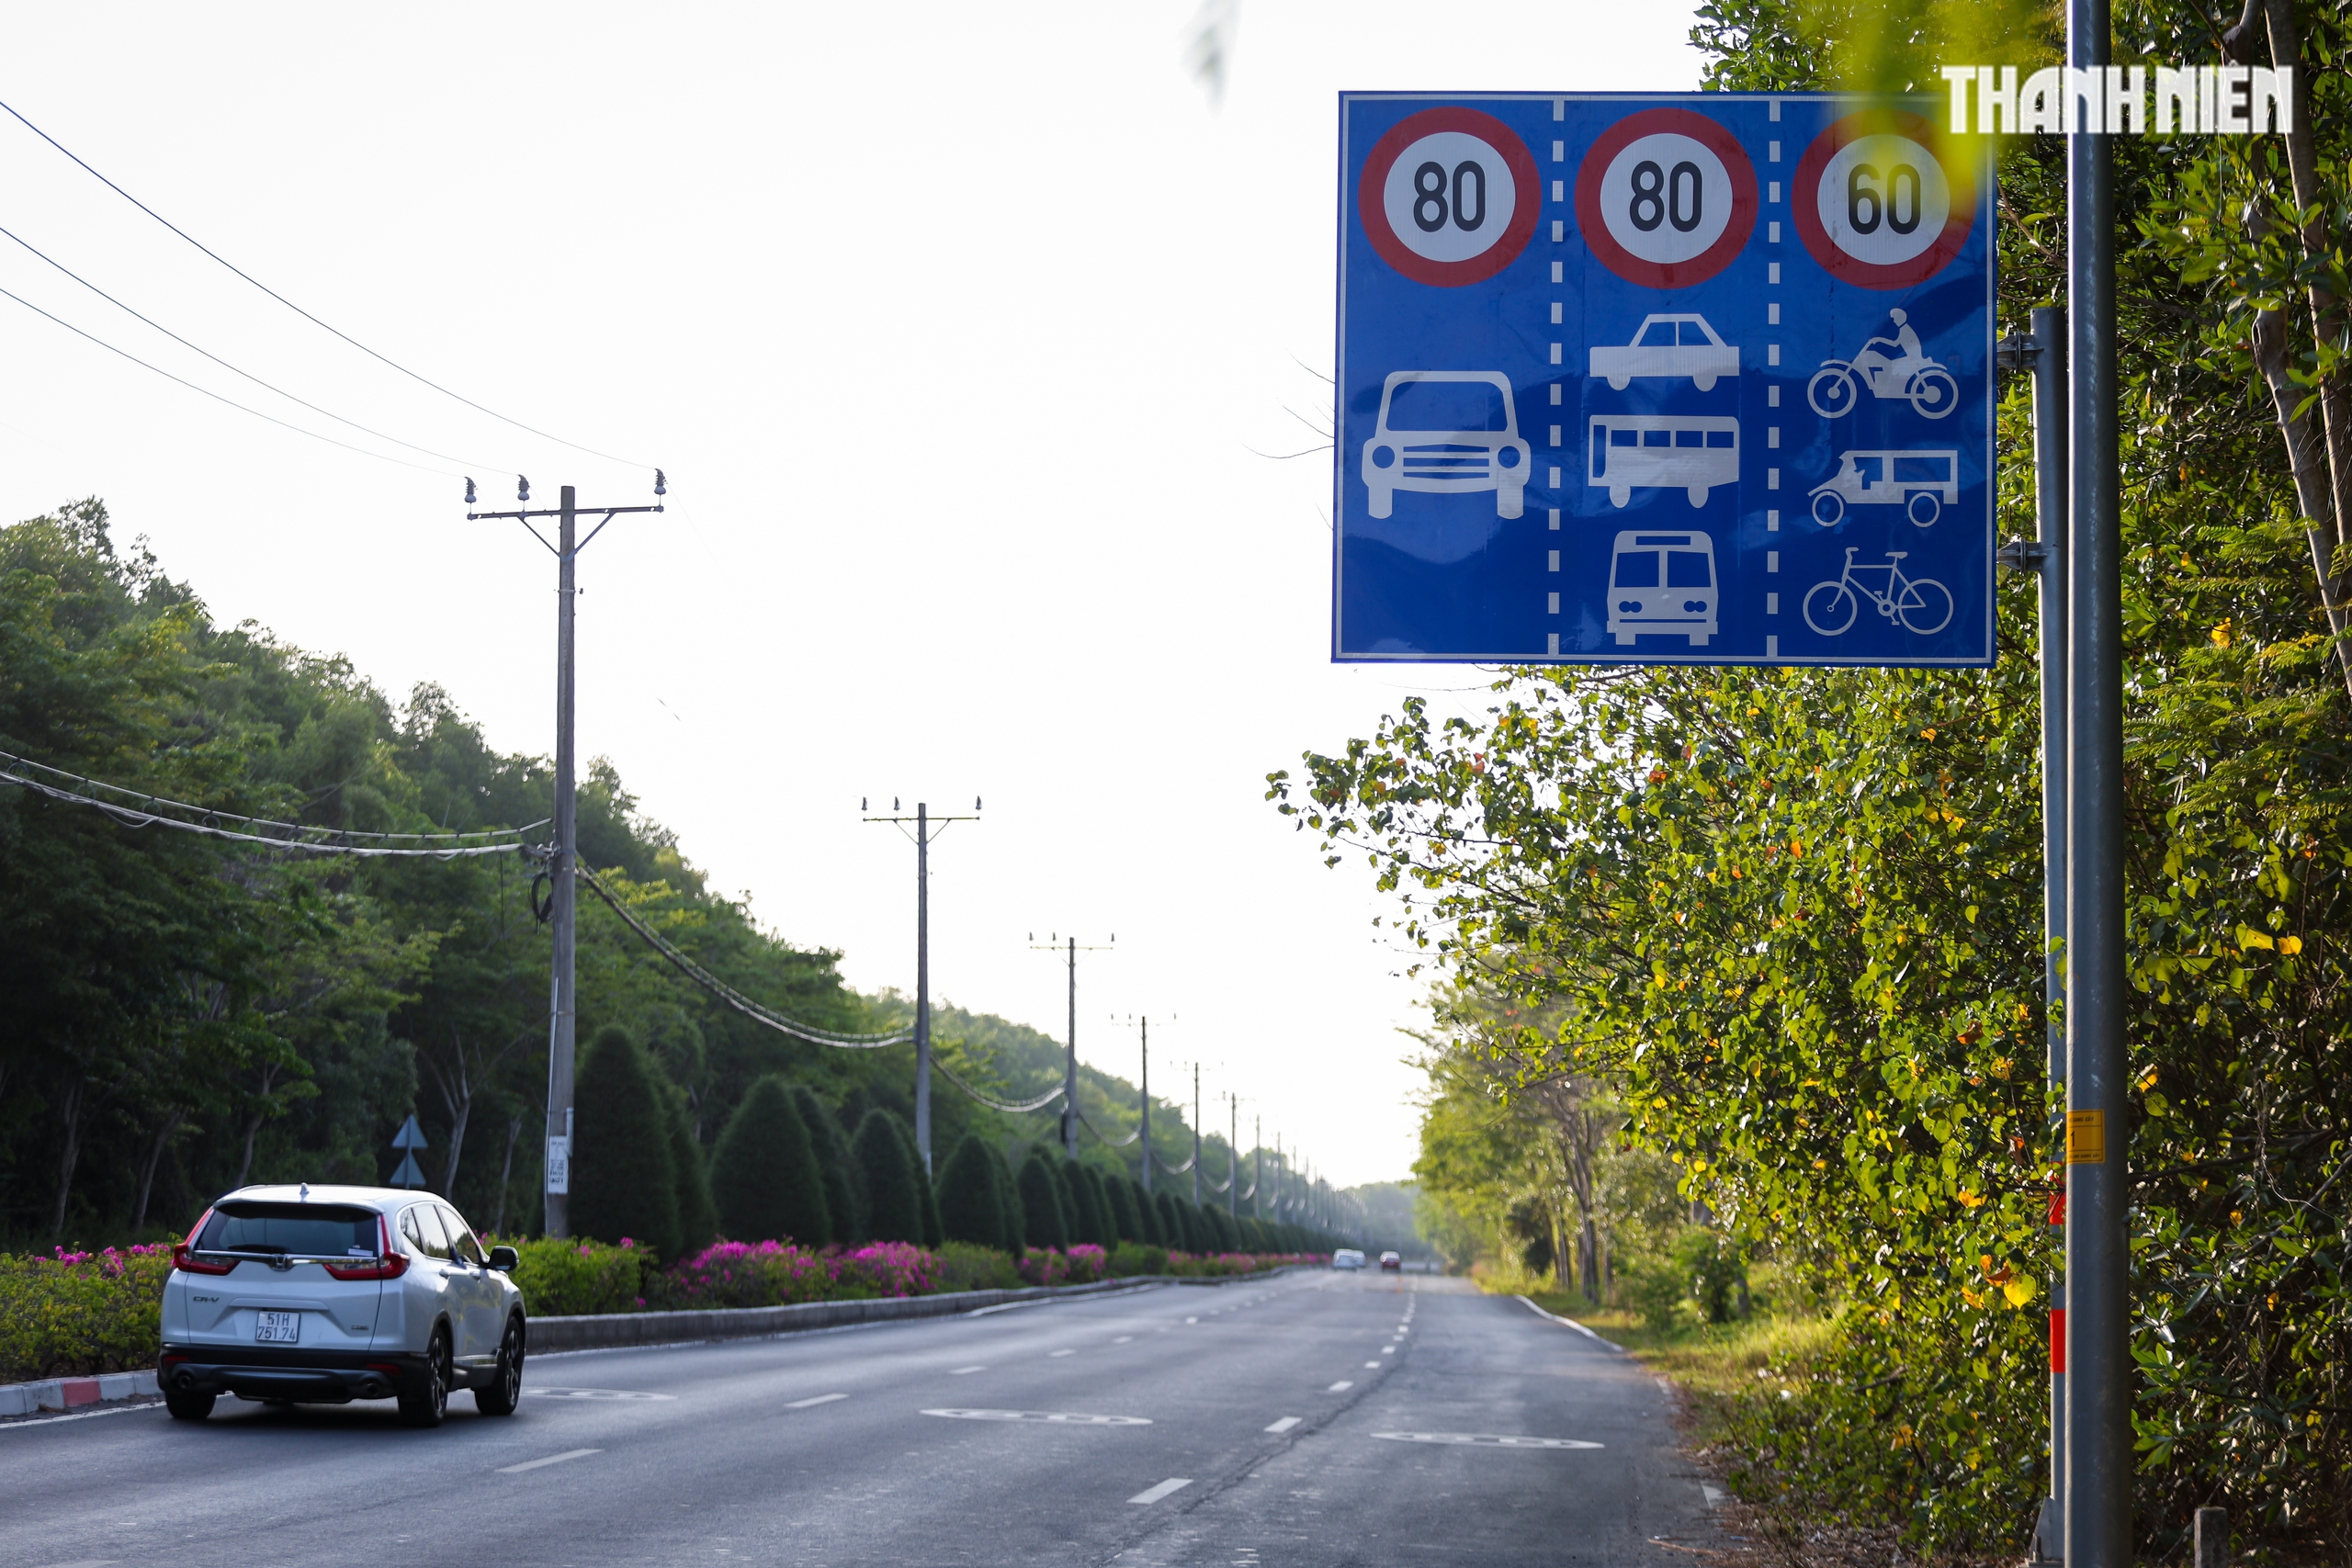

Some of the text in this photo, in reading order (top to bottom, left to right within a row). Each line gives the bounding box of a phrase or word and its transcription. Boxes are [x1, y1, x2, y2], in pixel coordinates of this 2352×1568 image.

[1413, 161, 1487, 232] 80
[1629, 160, 1702, 232] 80
[1848, 163, 1921, 235] 60
[257, 1325, 296, 1341] 751.74
[267, 1313, 290, 1326] 51H
